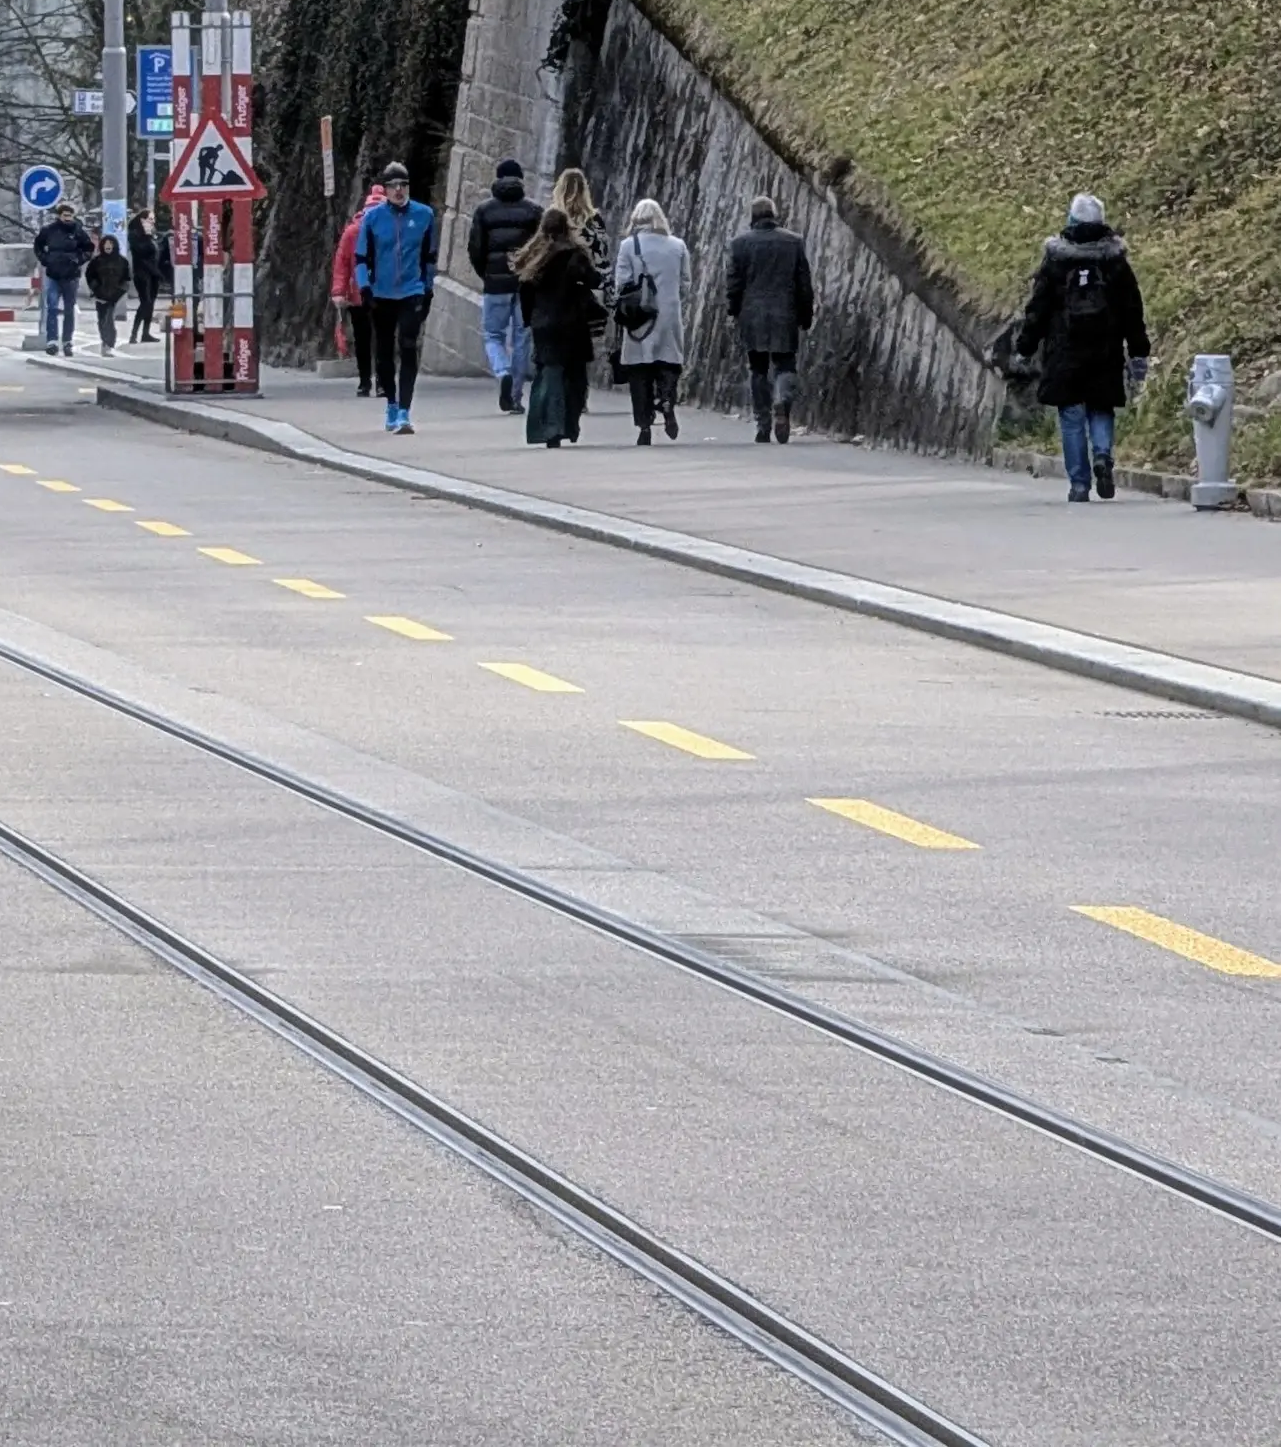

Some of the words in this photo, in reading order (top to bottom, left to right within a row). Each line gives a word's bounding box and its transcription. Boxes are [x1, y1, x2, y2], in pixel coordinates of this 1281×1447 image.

[175, 86, 188, 130] Frutiger
[235, 84, 248, 129] Frutiger
[176, 212, 190, 256] Frutiger
[206, 212, 220, 256] Frutiger
[236, 337, 252, 383] Frutiger
